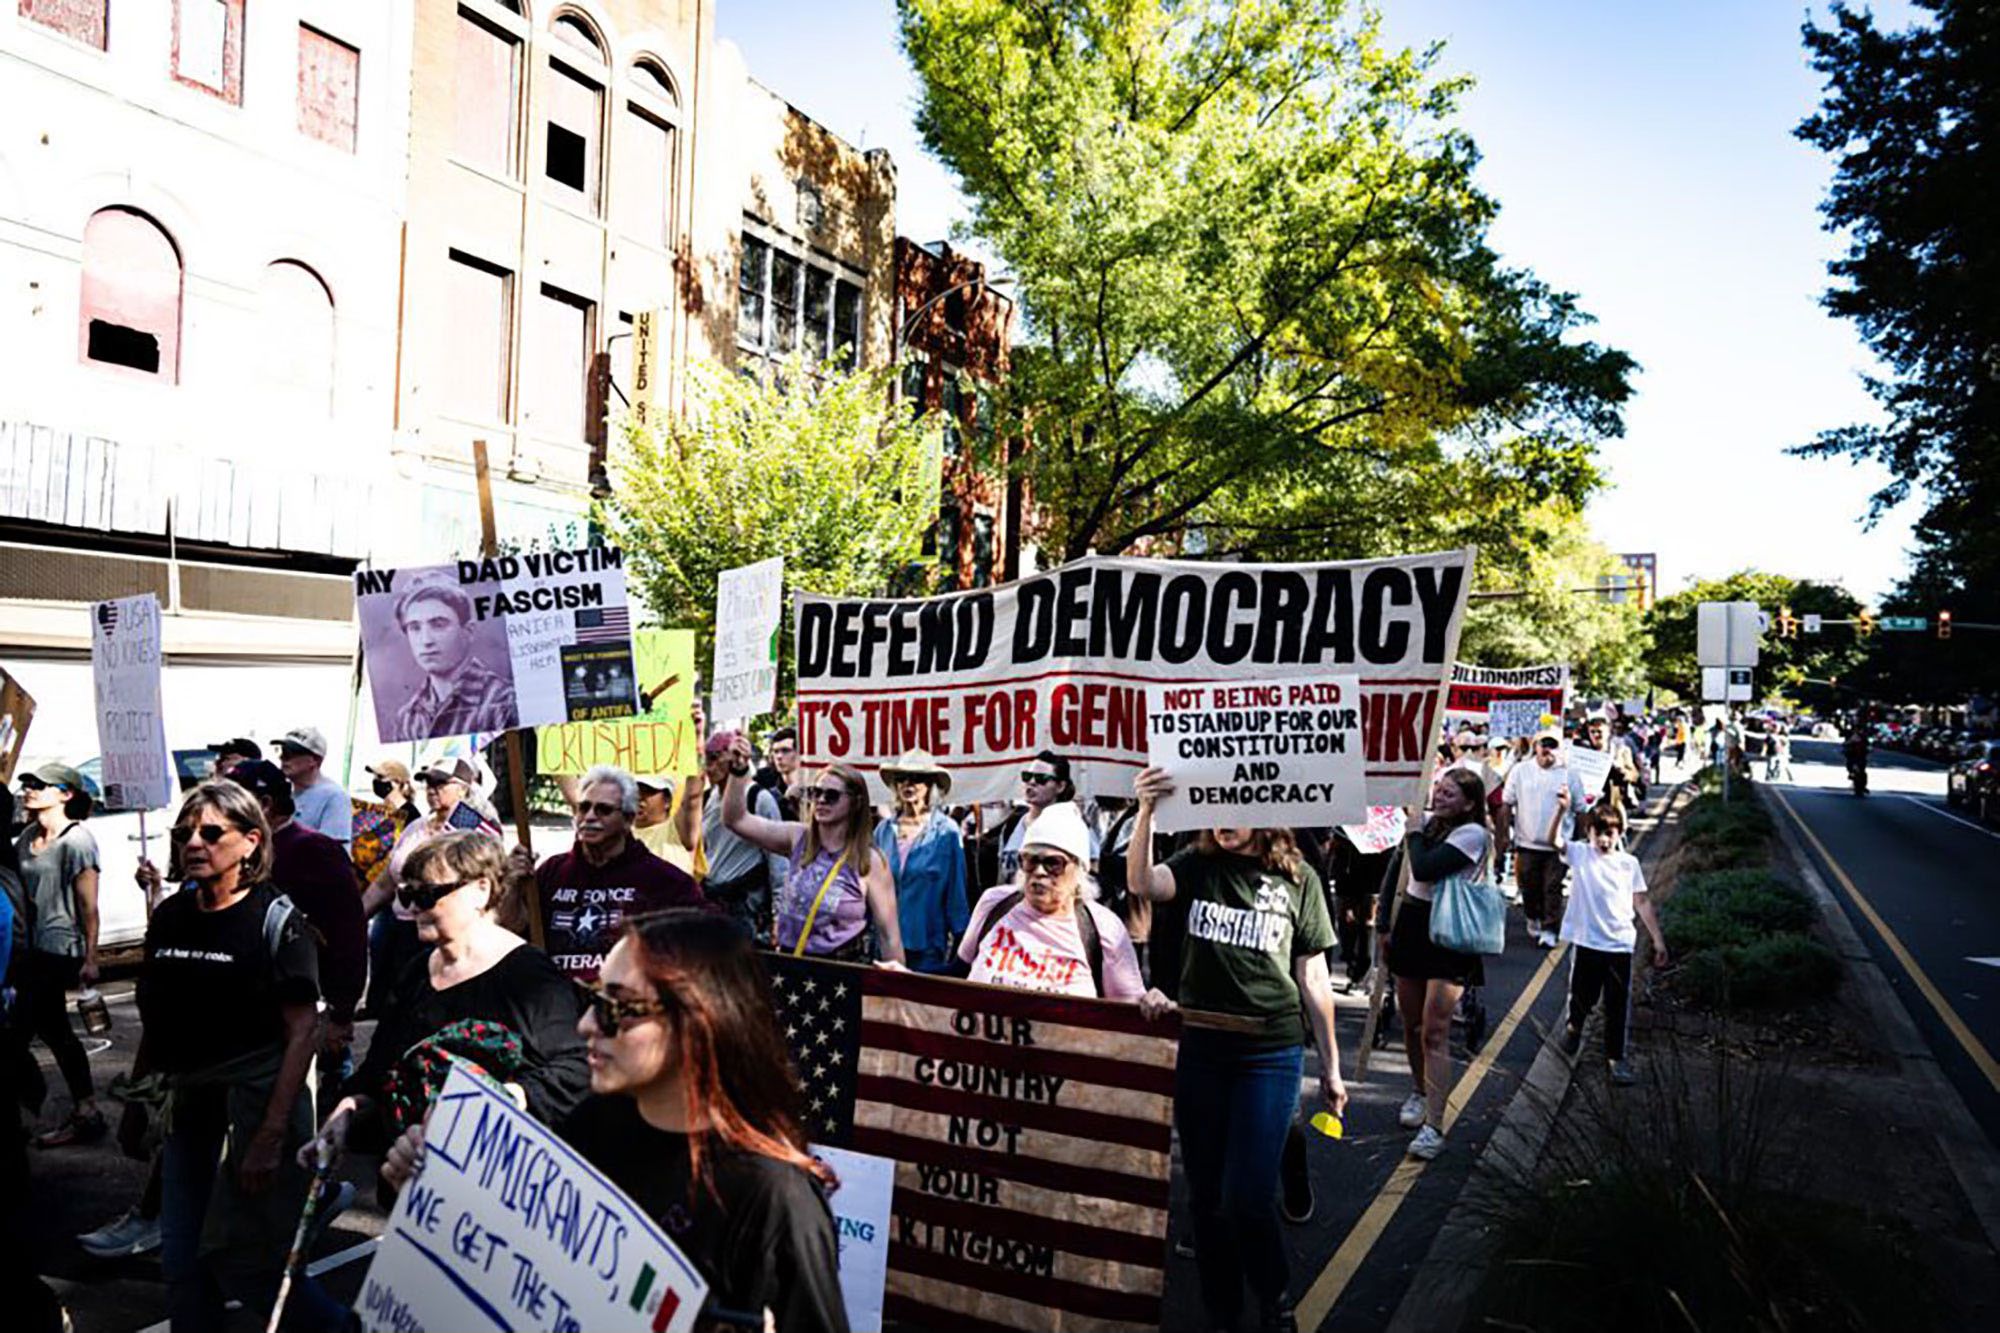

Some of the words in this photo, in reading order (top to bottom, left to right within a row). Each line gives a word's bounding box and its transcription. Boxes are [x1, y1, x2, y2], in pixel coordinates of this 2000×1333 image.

[637, 312, 649, 390] UNITED
[357, 569, 396, 596] MY
[458, 557, 519, 584] DAD
[524, 547, 621, 578] VICTIM
[474, 583, 603, 621] FASCISM
[798, 594, 994, 678] DEFEND
[1012, 565, 1464, 665] DEMOCRACY
[572, 707, 588, 720] OF
[591, 704, 633, 719] ANTIFA
[1164, 689, 1205, 711] NOT
[1213, 686, 1282, 709] BEING
[1288, 683, 1341, 706] PAID
[861, 697, 950, 757] TIME
[963, 689, 1038, 755] FOR
[1150, 714, 1175, 735] TO
[1276, 711, 1314, 732] FOR
[1318, 709, 1358, 730] OUR
[542, 719, 683, 774] CRUSHED!
[1178, 733, 1346, 759] CONSTITUTION
[1233, 762, 1280, 782] AND
[1189, 783, 1335, 805] DEMOCRACY
[552, 888, 578, 902] AIR
[954, 1009, 1035, 1046] OUR
[914, 1057, 1065, 1105] COUNTRY
[949, 1116, 1022, 1154] NOT
[425, 1091, 629, 1303] IMMIGRANTS,
[917, 1163, 1000, 1204] YOUR
[405, 1171, 446, 1234] WE
[452, 1211, 509, 1274] GET
[511, 1253, 549, 1320] THE
[898, 1216, 1054, 1276] KINGDOM
